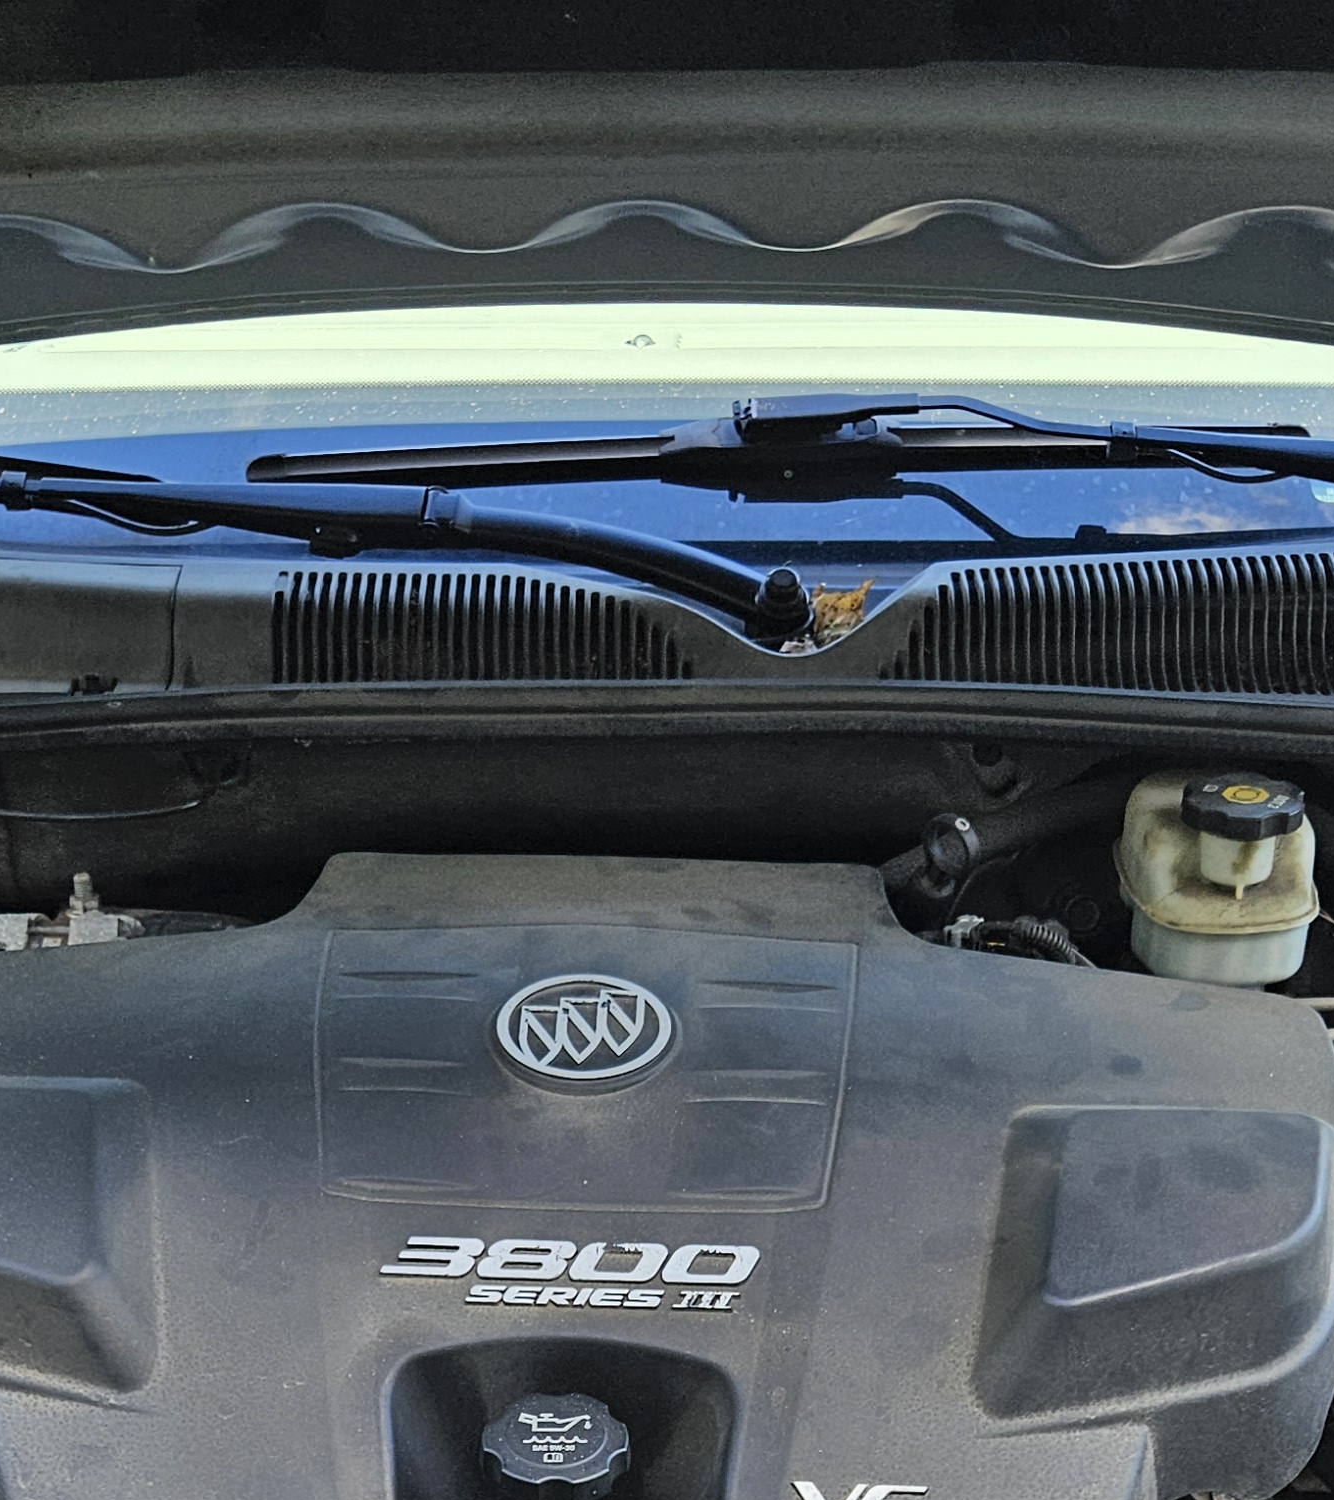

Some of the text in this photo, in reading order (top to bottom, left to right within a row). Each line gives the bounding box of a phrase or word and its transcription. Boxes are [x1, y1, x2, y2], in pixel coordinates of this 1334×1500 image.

[380, 1235, 760, 1285] 3800
[464, 1284, 740, 1312] SERIES III
